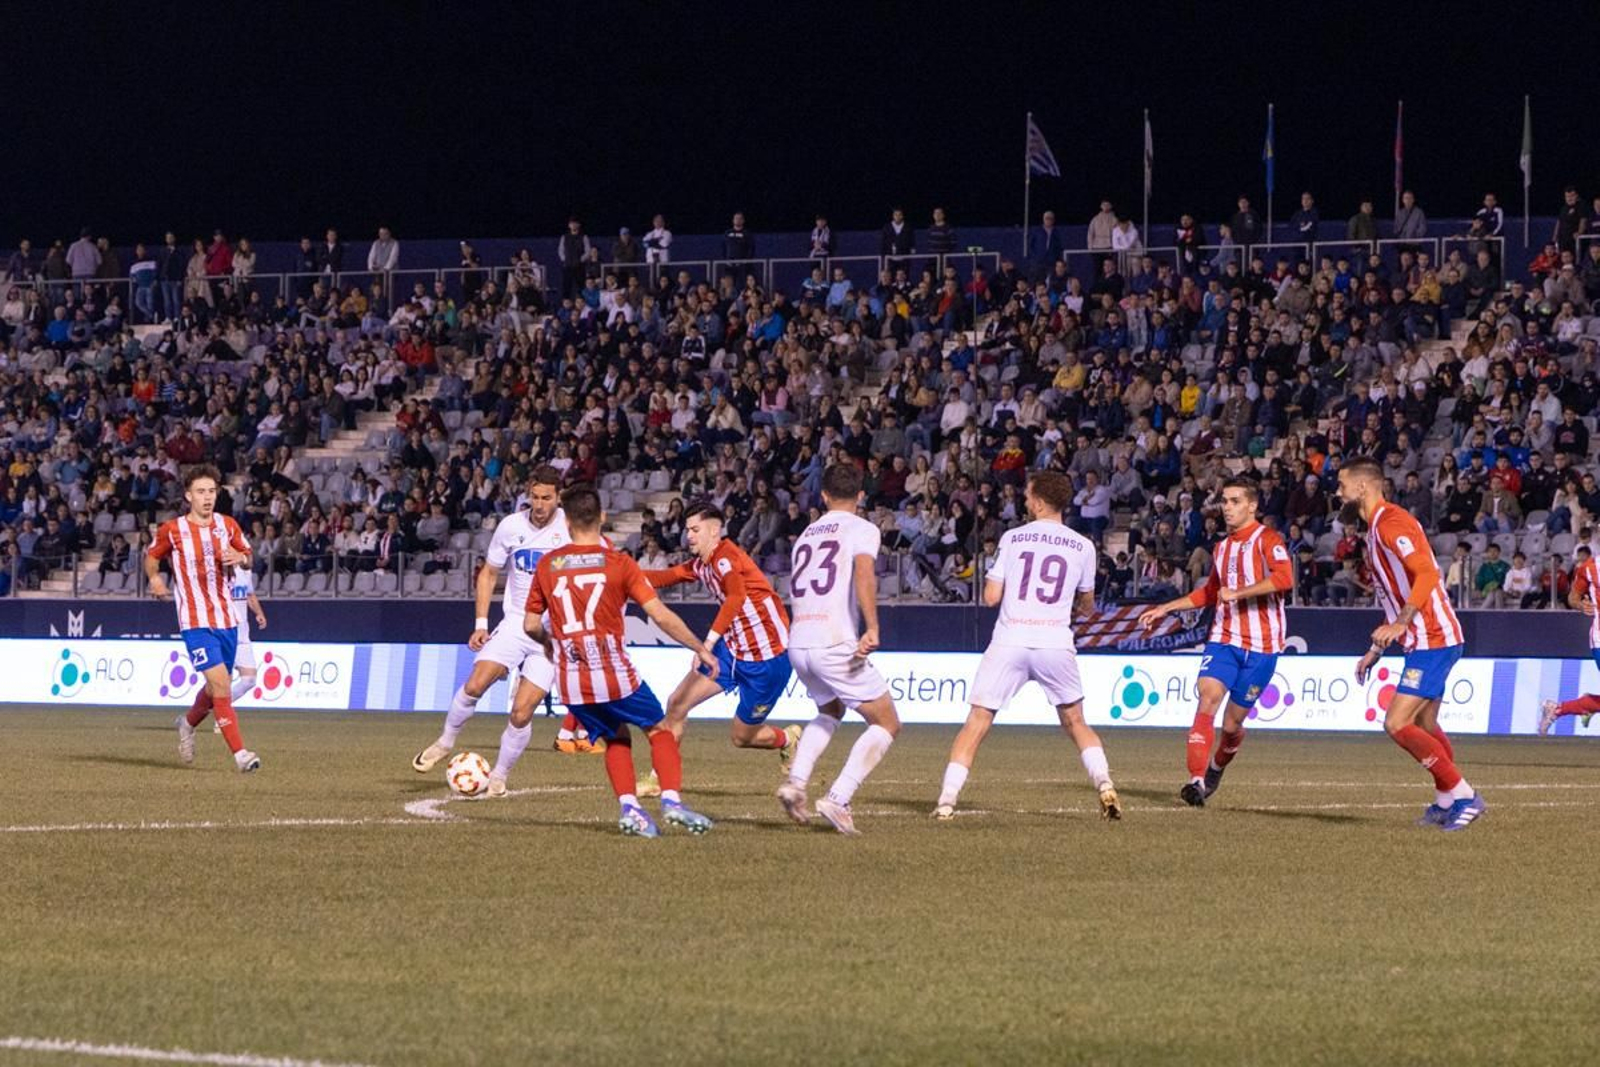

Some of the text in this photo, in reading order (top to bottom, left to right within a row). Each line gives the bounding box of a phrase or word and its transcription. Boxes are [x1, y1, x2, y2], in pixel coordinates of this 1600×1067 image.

[804, 523, 840, 538] CURRO
[1011, 533, 1084, 552] AGUS ALONSO
[790, 540, 841, 598] 23
[1018, 551, 1068, 604] 19
[552, 572, 607, 635] 17
[96, 657, 134, 681] ALO
[299, 660, 339, 685] ALO
[1165, 675, 1199, 702] AL
[1301, 677, 1350, 703] ALO
